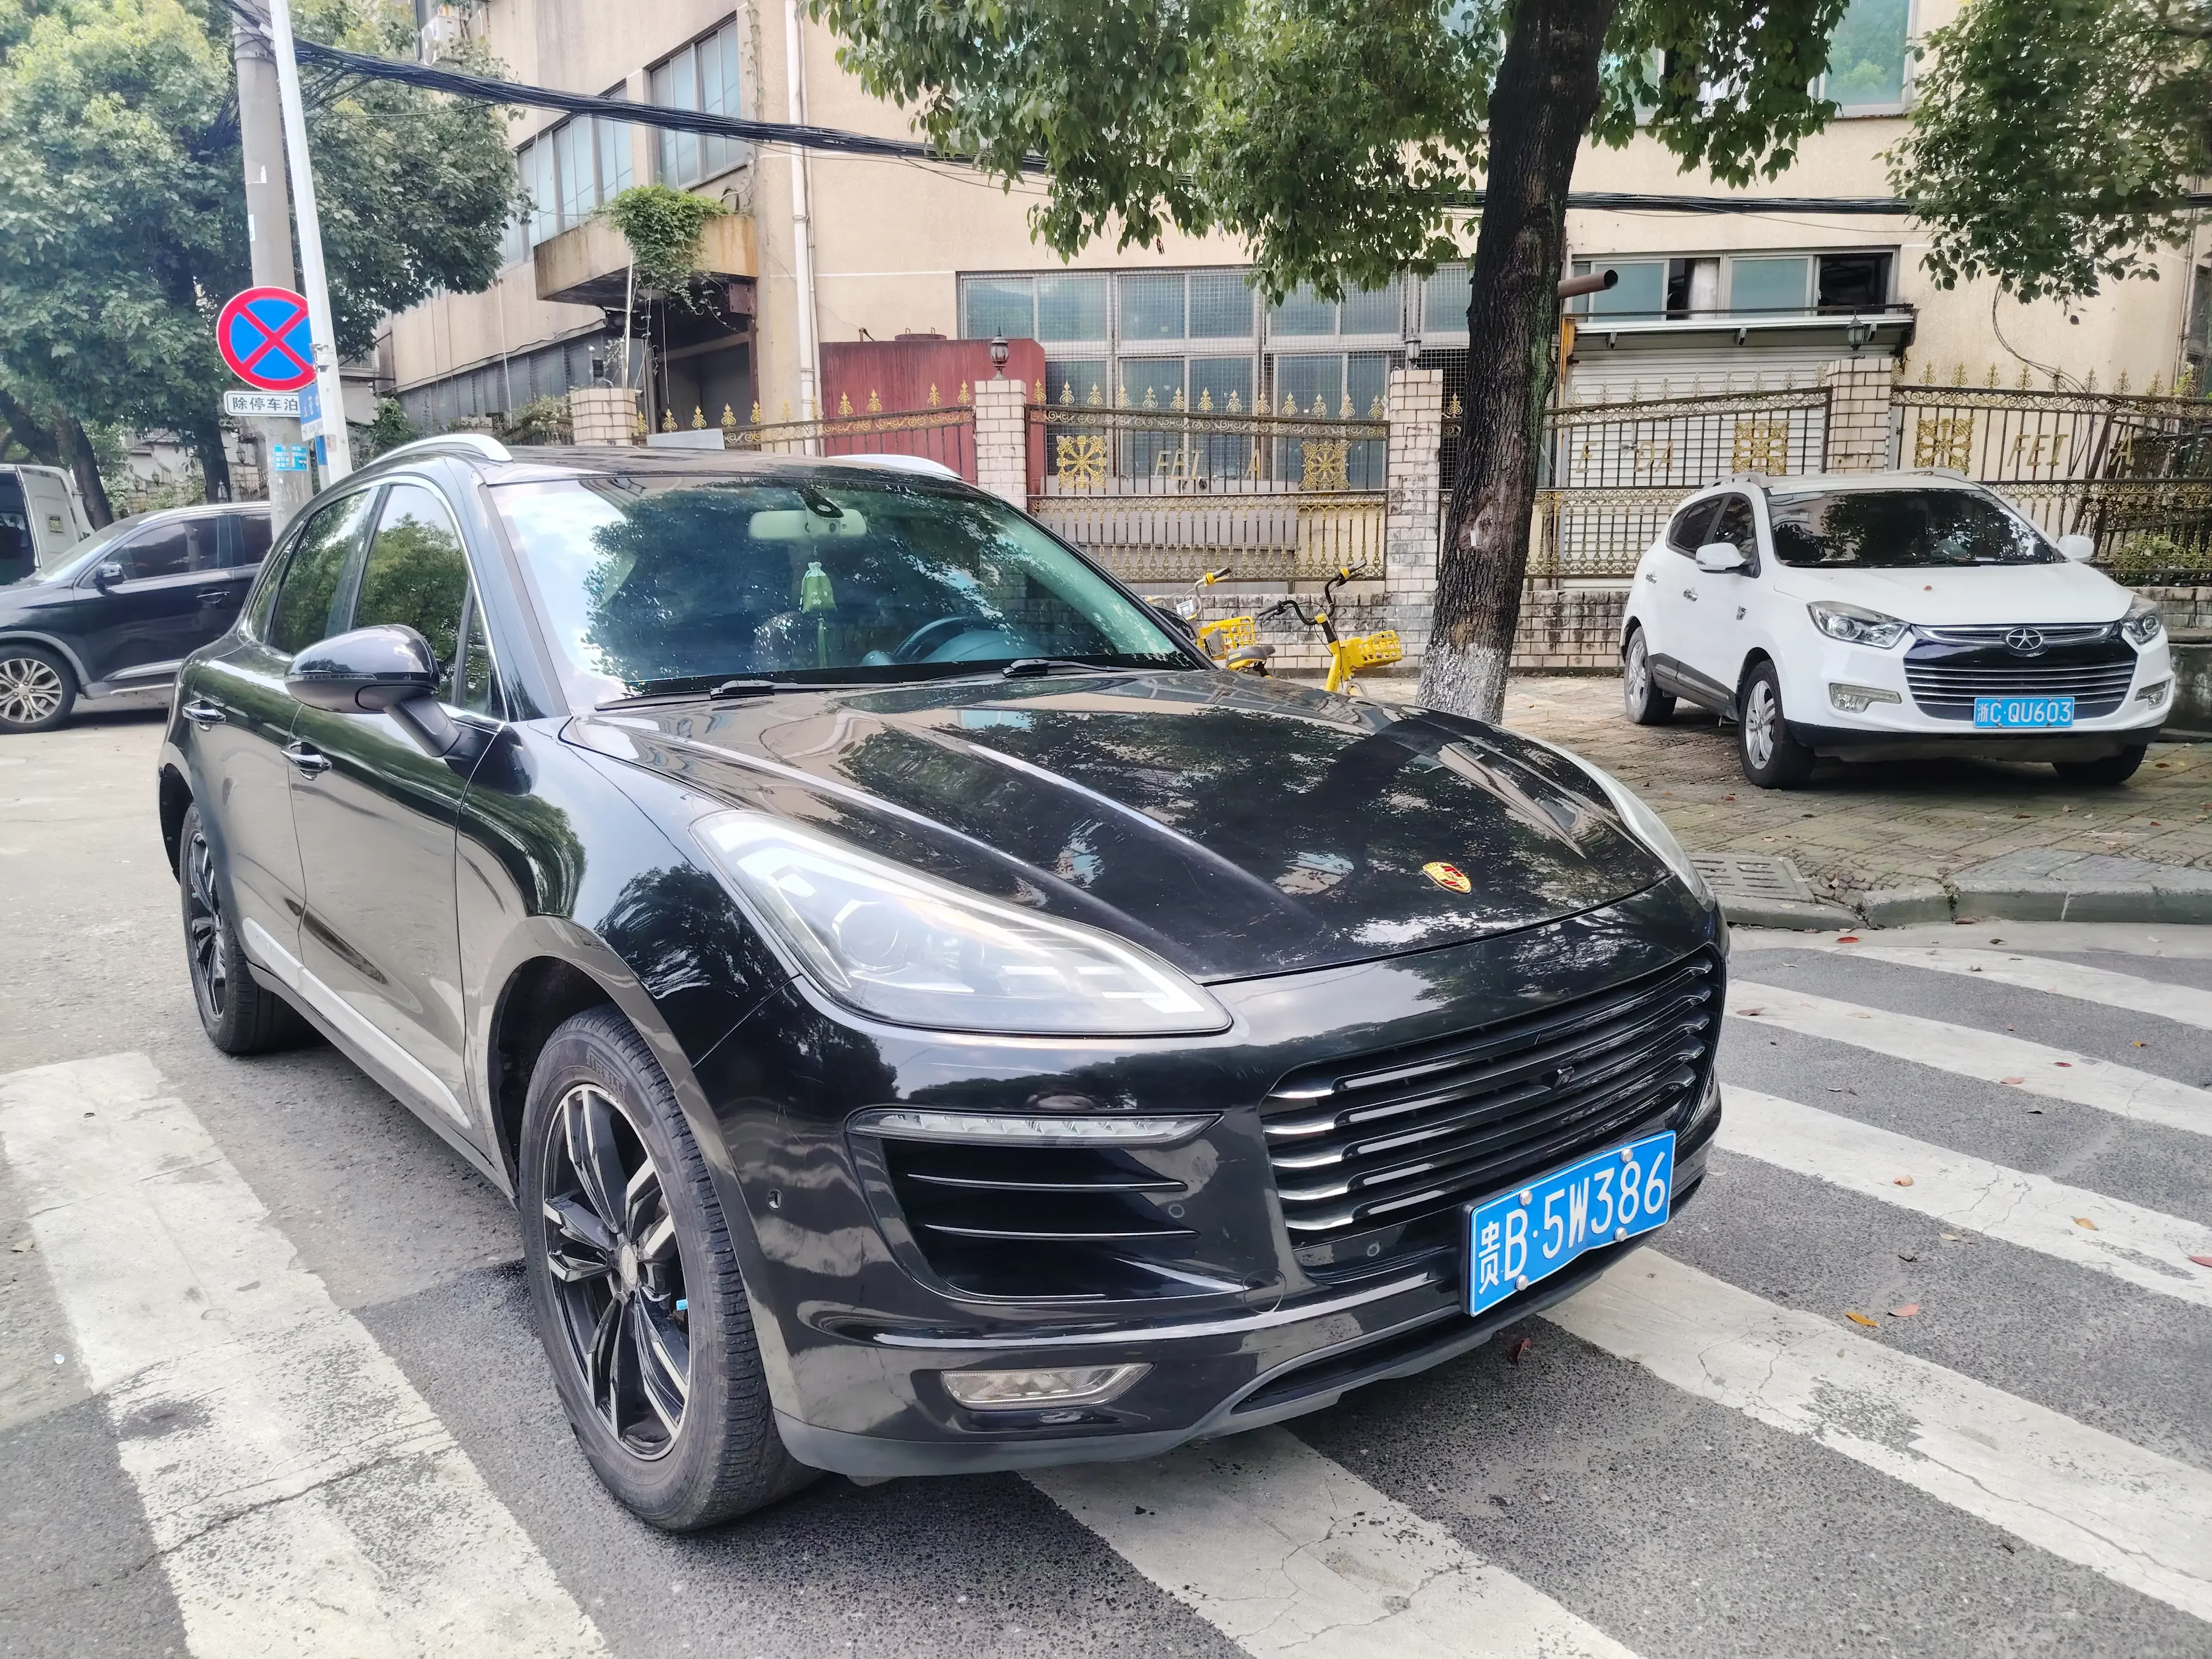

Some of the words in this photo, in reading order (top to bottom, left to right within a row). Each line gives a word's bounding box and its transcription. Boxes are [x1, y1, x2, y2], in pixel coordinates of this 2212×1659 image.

[232, 397, 299, 411] 除停车泊
[1154, 450, 1204, 481] FEI
[1245, 448, 1260, 479] A
[1576, 442, 1597, 473] E
[1635, 440, 1673, 473] DA
[2007, 434, 2069, 467] FEI
[2110, 432, 2133, 467] A
[1478, 1151, 1666, 1295] 贵B·5W386
